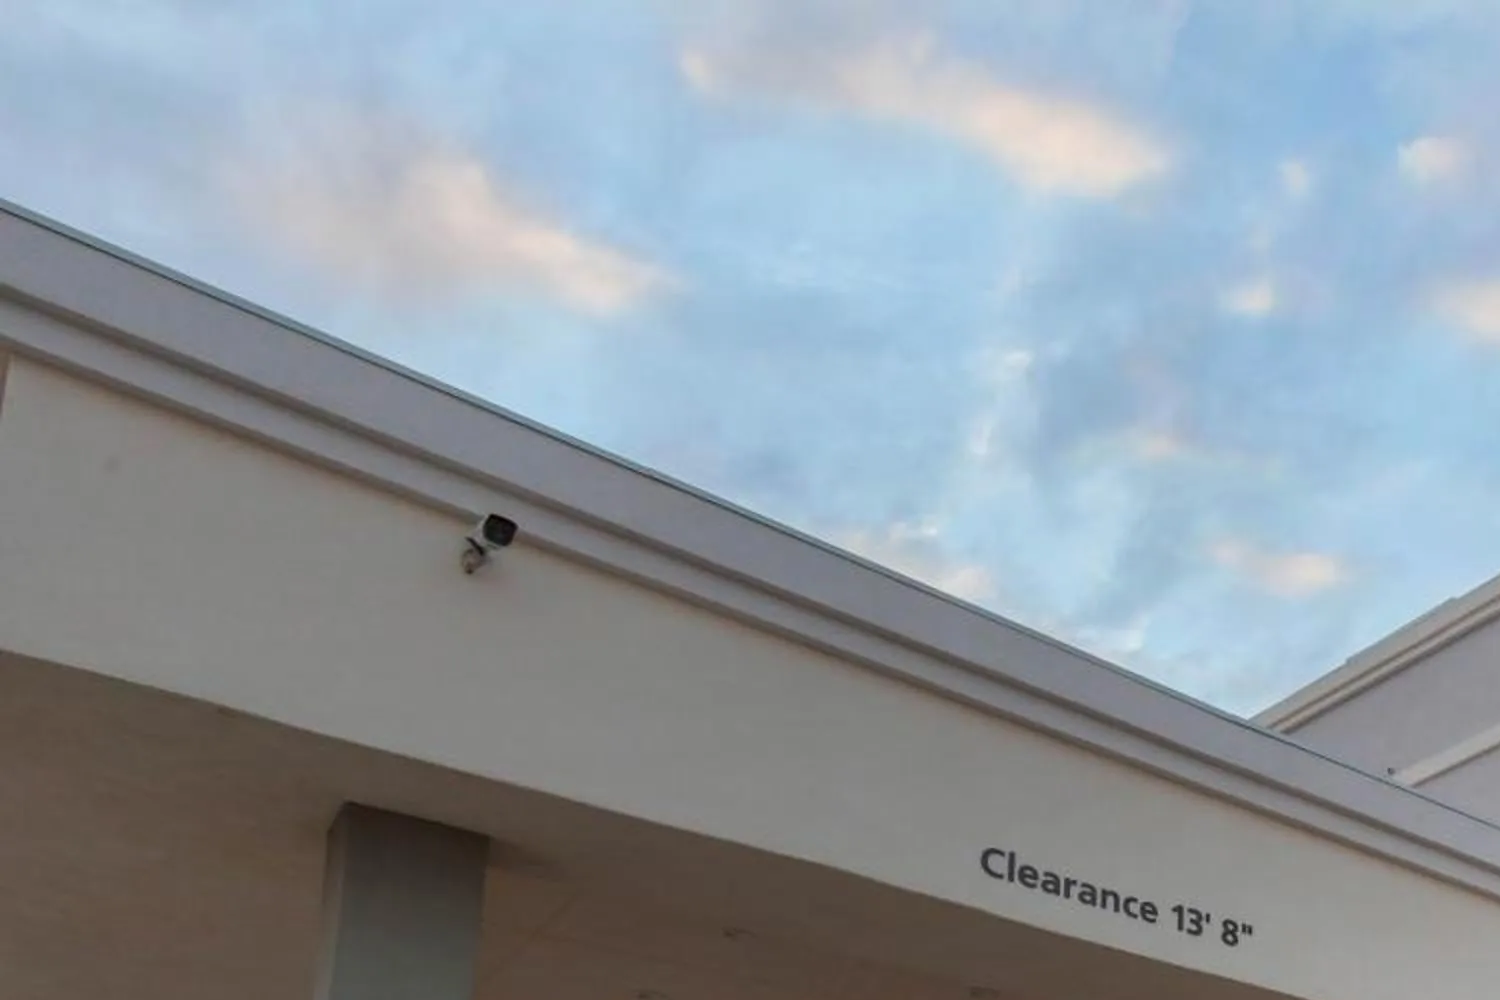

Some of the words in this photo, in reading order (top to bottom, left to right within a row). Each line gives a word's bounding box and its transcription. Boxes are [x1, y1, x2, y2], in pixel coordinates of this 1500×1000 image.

[980, 847, 1159, 924] Clearance
[1171, 904, 1211, 937] 13'
[1221, 918, 1253, 947] 8"
